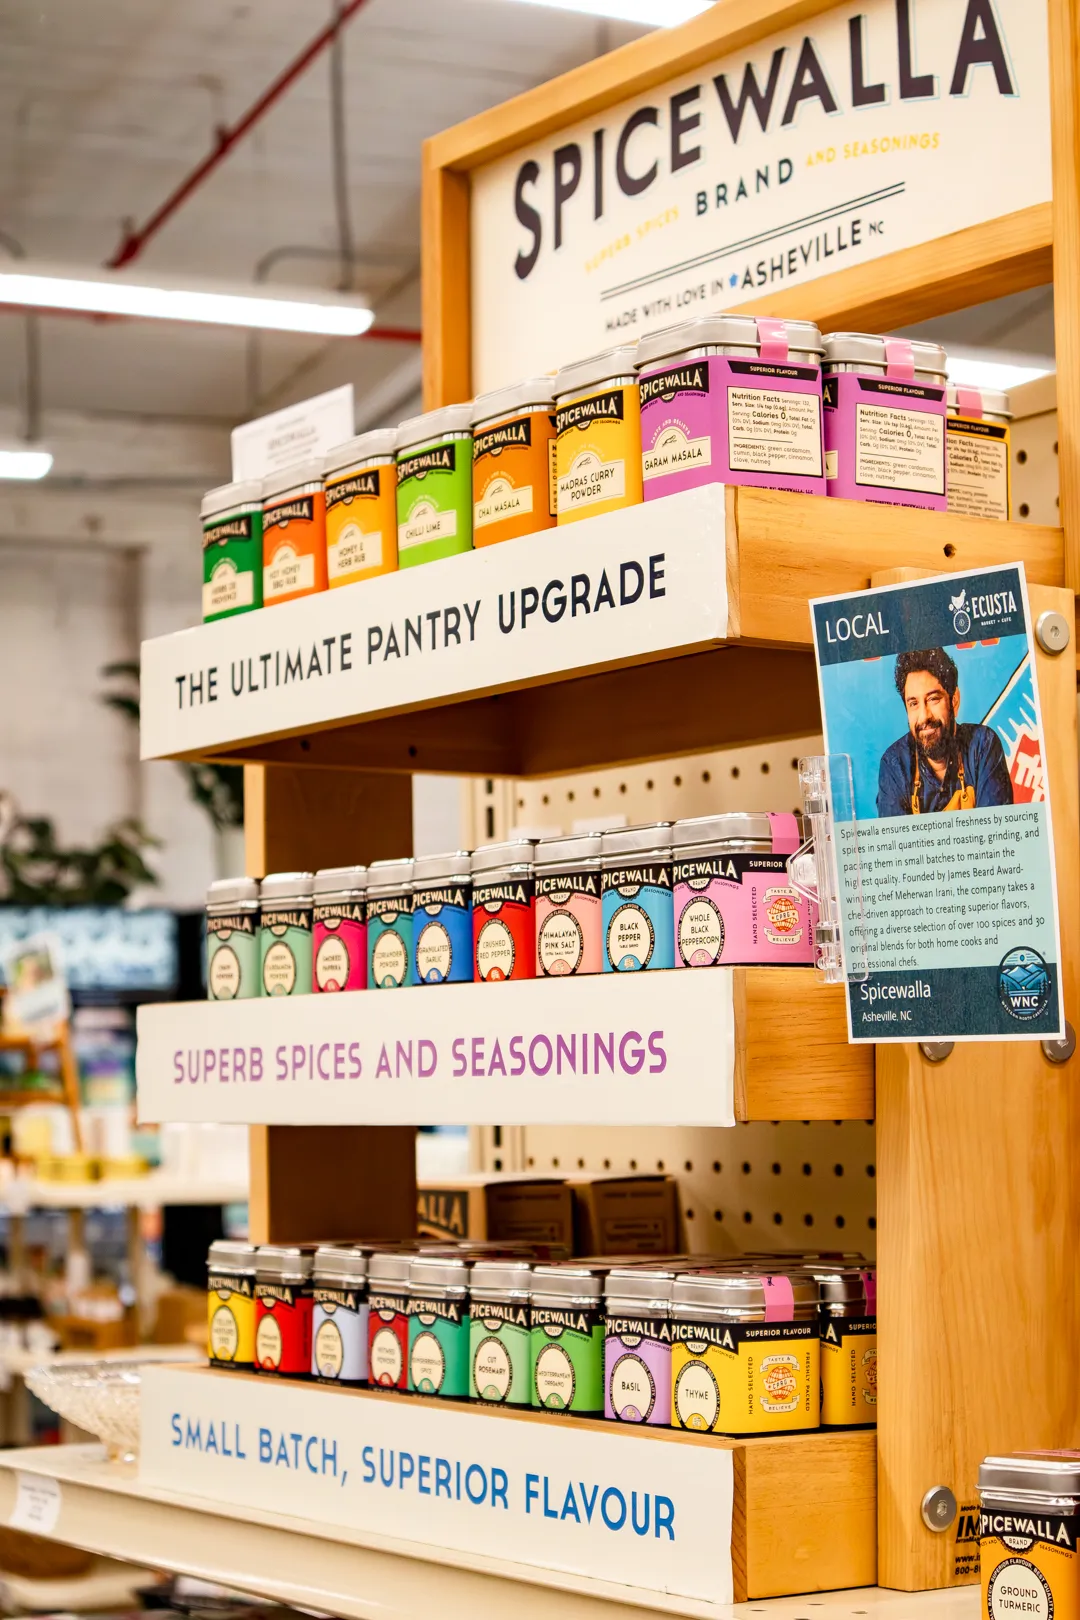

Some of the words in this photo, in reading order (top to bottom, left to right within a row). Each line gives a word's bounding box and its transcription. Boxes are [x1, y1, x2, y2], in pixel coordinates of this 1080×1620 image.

[513, 0, 1014, 282] SPICEWALLA
[695, 157, 794, 217] BRAND
[805, 146, 836, 168] AND
[843, 132, 941, 161] SEASONINGS
[605, 307, 638, 332] MADE
[641, 294, 672, 320] WITH
[675, 285, 707, 308] LOVE
[710, 279, 724, 292] IN
[740, 219, 863, 290] ASHEVILLE
[868, 220, 885, 237] NC
[640, 368, 702, 403] SPICEWALLA
[732, 393, 760, 401] Nutrition
[556, 398, 617, 432] SPICEWALLA
[752, 411, 779, 419] Calories
[645, 456, 668, 470] GARAM
[672, 448, 702, 462] MASALA
[560, 476, 588, 492] MADRAS
[590, 468, 615, 483] CURRY
[571, 485, 601, 501] POWDER
[478, 504, 492, 518] CHAI
[495, 499, 520, 512] MASALA
[972, 591, 1017, 619] ECUSTA
[176, 667, 218, 710] THE
[230, 632, 352, 696] ULTIMATE
[367, 600, 482, 665] PANTRY
[499, 553, 666, 634] UPGRADE
[826, 612, 889, 643] LOCAL
[882, 825, 910, 834] ensures
[912, 818, 953, 833] exceptional
[956, 816, 991, 828] freshness
[994, 814, 1002, 826] by
[1005, 811, 1038, 823] sourcing
[868, 844, 874, 852] in
[877, 840, 896, 851] small
[899, 838, 934, 852] quantities
[937, 835, 950, 846] and
[953, 834, 985, 845] roasting,
[988, 830, 1022, 844] grinding,
[1025, 827, 1039, 838] and
[874, 858, 893, 868] them
[896, 858, 902, 866] in
[905, 855, 924, 865] small
[926, 852, 955, 864] batches
[967, 850, 1000, 860] maintain
[1002, 847, 1015, 857] the
[601, 868, 670, 891] PICEWALLA
[673, 859, 738, 882] PICEWALLA
[875, 874, 900, 887] quality.
[903, 871, 934, 882] Founded
[937, 870, 945, 882] by
[948, 870, 970, 881] James
[973, 866, 994, 877] Beard
[997, 863, 1023, 875] Award-
[472, 885, 527, 906] PICEWALLA
[536, 876, 596, 896] PICEWALLA
[878, 891, 893, 902] chef
[895, 889, 933, 900] Meherwan
[936, 888, 955, 898] Irani,
[957, 885, 968, 895] the
[971, 884, 1005, 896] company
[1008, 881, 1027, 891] takes
[1030, 882, 1035, 890] a
[413, 889, 464, 907] PICEWALLA
[689, 914, 710, 922] WHOLE
[891, 905, 923, 919] approach
[926, 906, 933, 914] to
[936, 903, 966, 915] creating
[968, 902, 999, 914] superior
[1002, 899, 1029, 909] flavors,
[620, 922, 639, 931] BLACK
[691, 925, 709, 934] BLACK
[886, 925, 911, 934] diverse
[914, 922, 946, 932] selection
[948, 920, 956, 930] of
[958, 921, 973, 929] over
[977, 920, 989, 928] 100
[992, 918, 1015, 930] spices
[1018, 914, 1033, 925] and
[1036, 916, 1045, 927] 30
[483, 940, 506, 949] CRUSHED
[544, 930, 577, 939] HIMALAYAN
[561, 940, 575, 949] SALT
[618, 934, 641, 942] PEPPER
[682, 936, 720, 945] PEPPERCORN
[881, 941, 904, 951] blends
[906, 939, 915, 949] for
[918, 938, 934, 948] both
[937, 938, 958, 947] home
[961, 936, 982, 946] cooks
[985, 934, 998, 945] and
[480, 951, 490, 959] RED
[491, 949, 511, 958] PEPPER
[899, 956, 918, 966] chefs.
[860, 981, 931, 1004] Spicewalla
[1011, 996, 1039, 1007] WNC
[862, 1011, 898, 1022] Asheville,
[901, 1011, 912, 1021] NC
[173, 1046, 264, 1084] SUPERB
[276, 1042, 362, 1081] SPICES
[375, 1039, 437, 1079] AND
[452, 1031, 667, 1077] SEASONINGS
[471, 1304, 527, 1327] PICEWALLA
[531, 1310, 588, 1332] PICEWALLA
[605, 1319, 671, 1342] PICEWALLA
[671, 1324, 734, 1349] PICEWALLA
[746, 1329, 780, 1338] SUPERIOR
[783, 1327, 811, 1335] FLAVOUR
[479, 1366, 506, 1375] ROSEMARY
[621, 1381, 641, 1392] BASIL
[685, 1388, 709, 1400] THYME
[171, 1413, 246, 1460] SMALL
[259, 1428, 347, 1487] BATCH,
[362, 1446, 509, 1510] SUPERIOR
[525, 1473, 676, 1541] FLAVOUR
[1009, 1538, 1028, 1546] BRAND
[1039, 1544, 1073, 1559] SEASONINGS
[1000, 1586, 1038, 1599] GROUND
[999, 1599, 1041, 1613] TURMERIC
